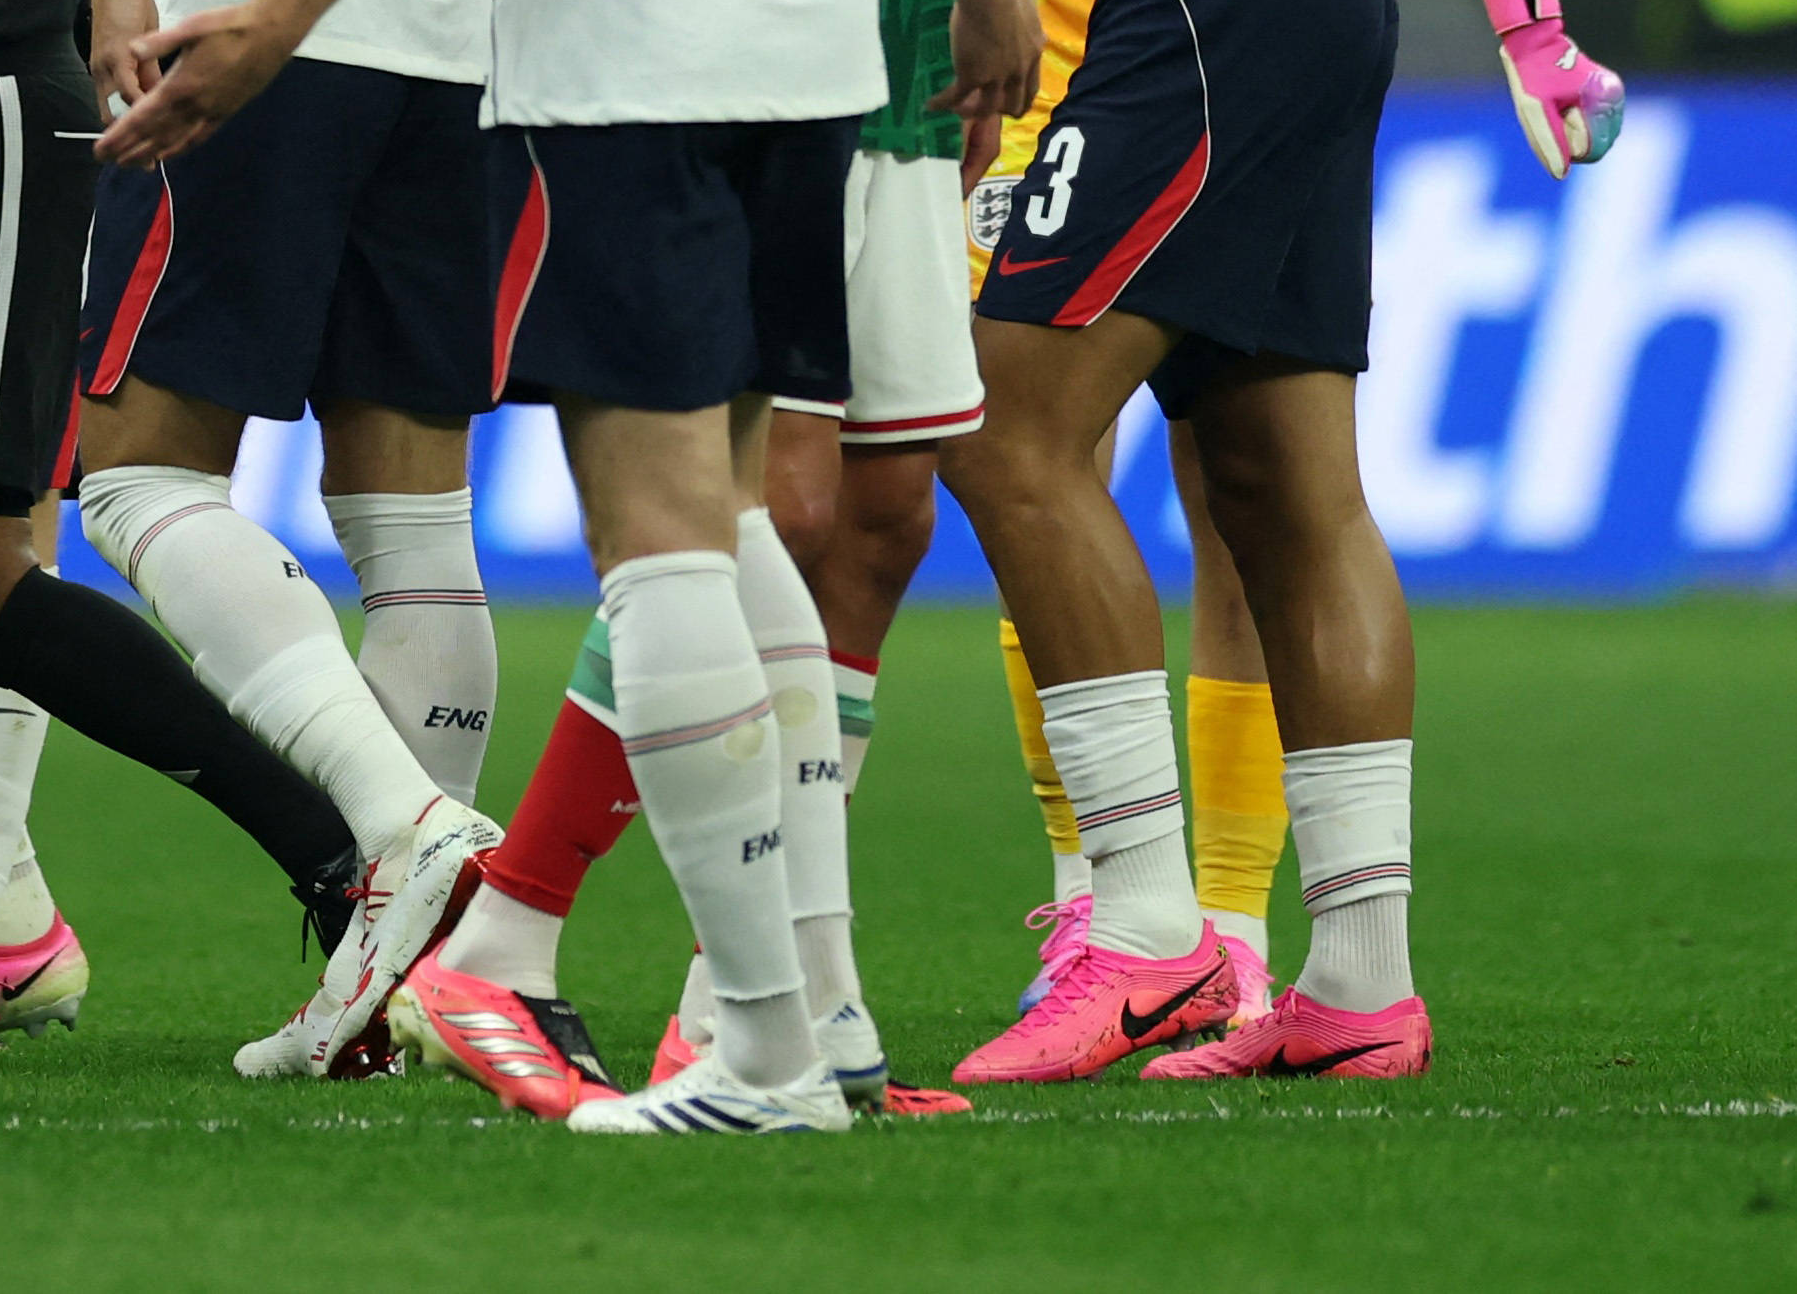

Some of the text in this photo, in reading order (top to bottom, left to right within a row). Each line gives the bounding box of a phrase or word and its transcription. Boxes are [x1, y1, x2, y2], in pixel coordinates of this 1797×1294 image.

[1025, 126, 1086, 237] 3
[424, 705, 488, 733] ENG
[742, 826, 782, 864] EN
